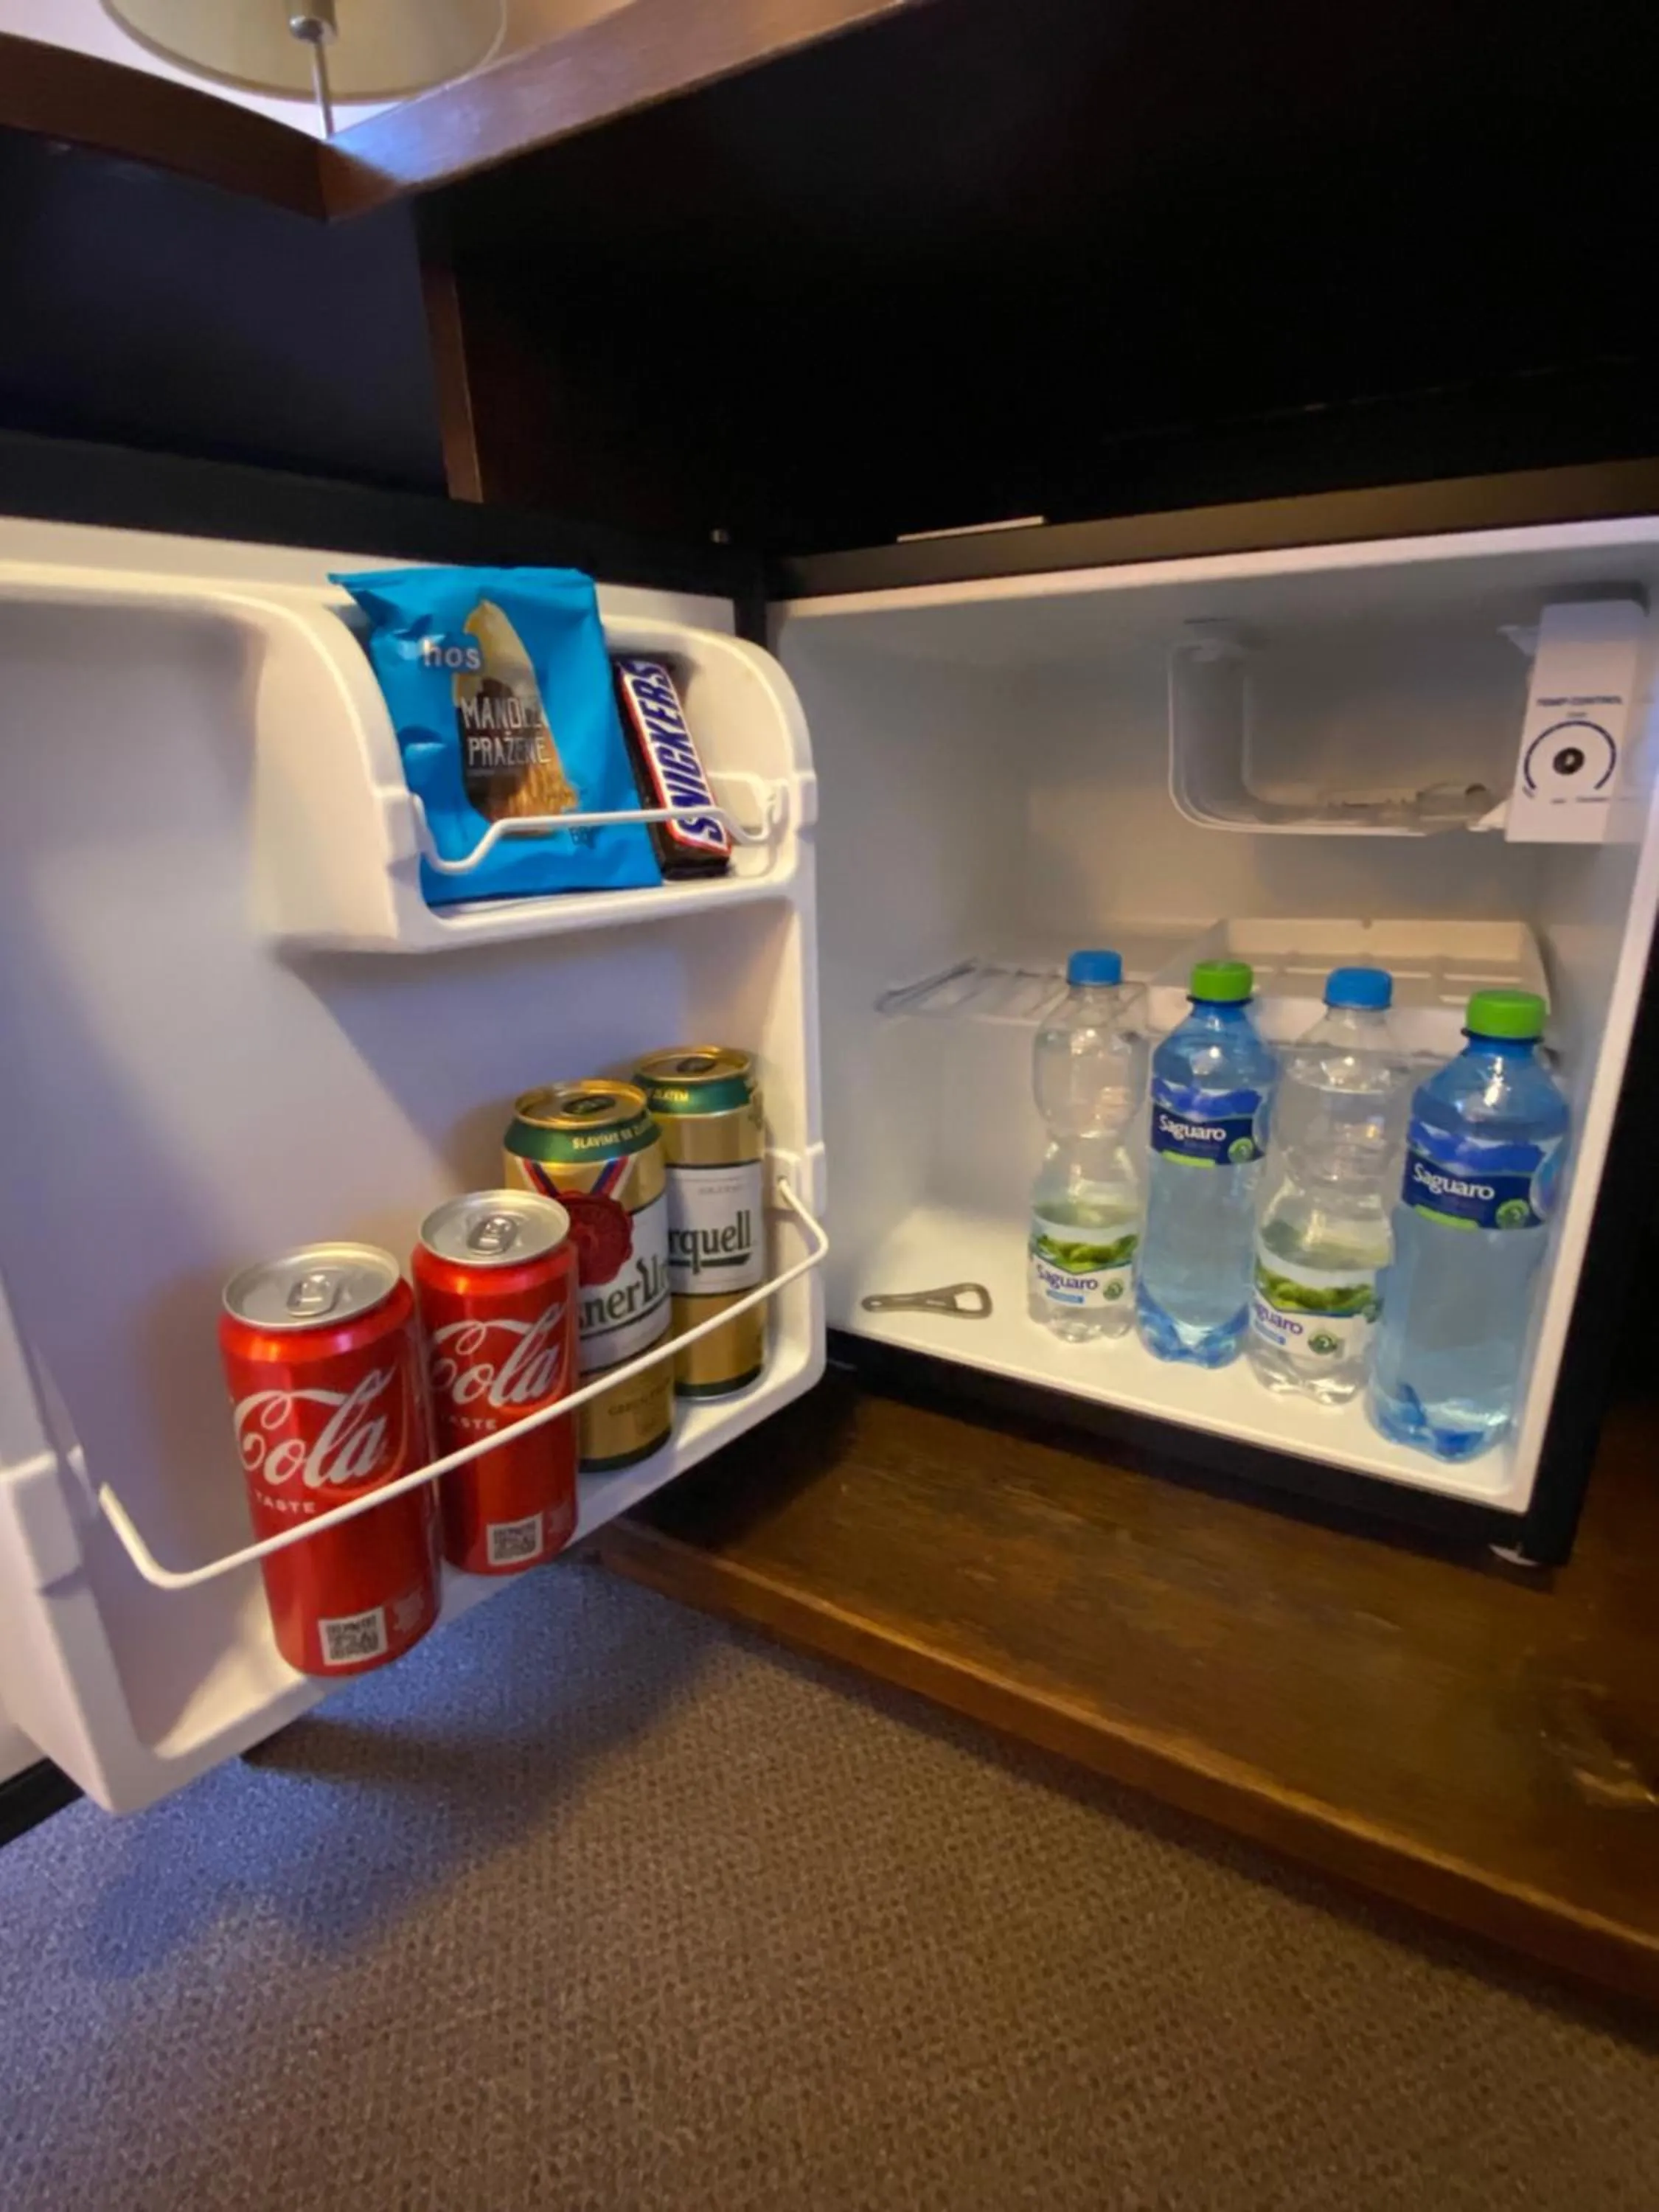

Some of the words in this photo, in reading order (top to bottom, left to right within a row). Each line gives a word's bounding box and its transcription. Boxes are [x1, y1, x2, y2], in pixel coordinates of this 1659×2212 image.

[624, 661, 724, 844] SNICKERS
[1159, 1114, 1226, 1141] Saguaro
[1413, 1162, 1495, 1201] Saguaro
[667, 1209, 751, 1276] rquell
[579, 1281, 640, 1329] ner
[1036, 1264, 1099, 1290] Saguaro
[431, 1301, 566, 1408] Cola
[234, 1362, 396, 1489] Cola
